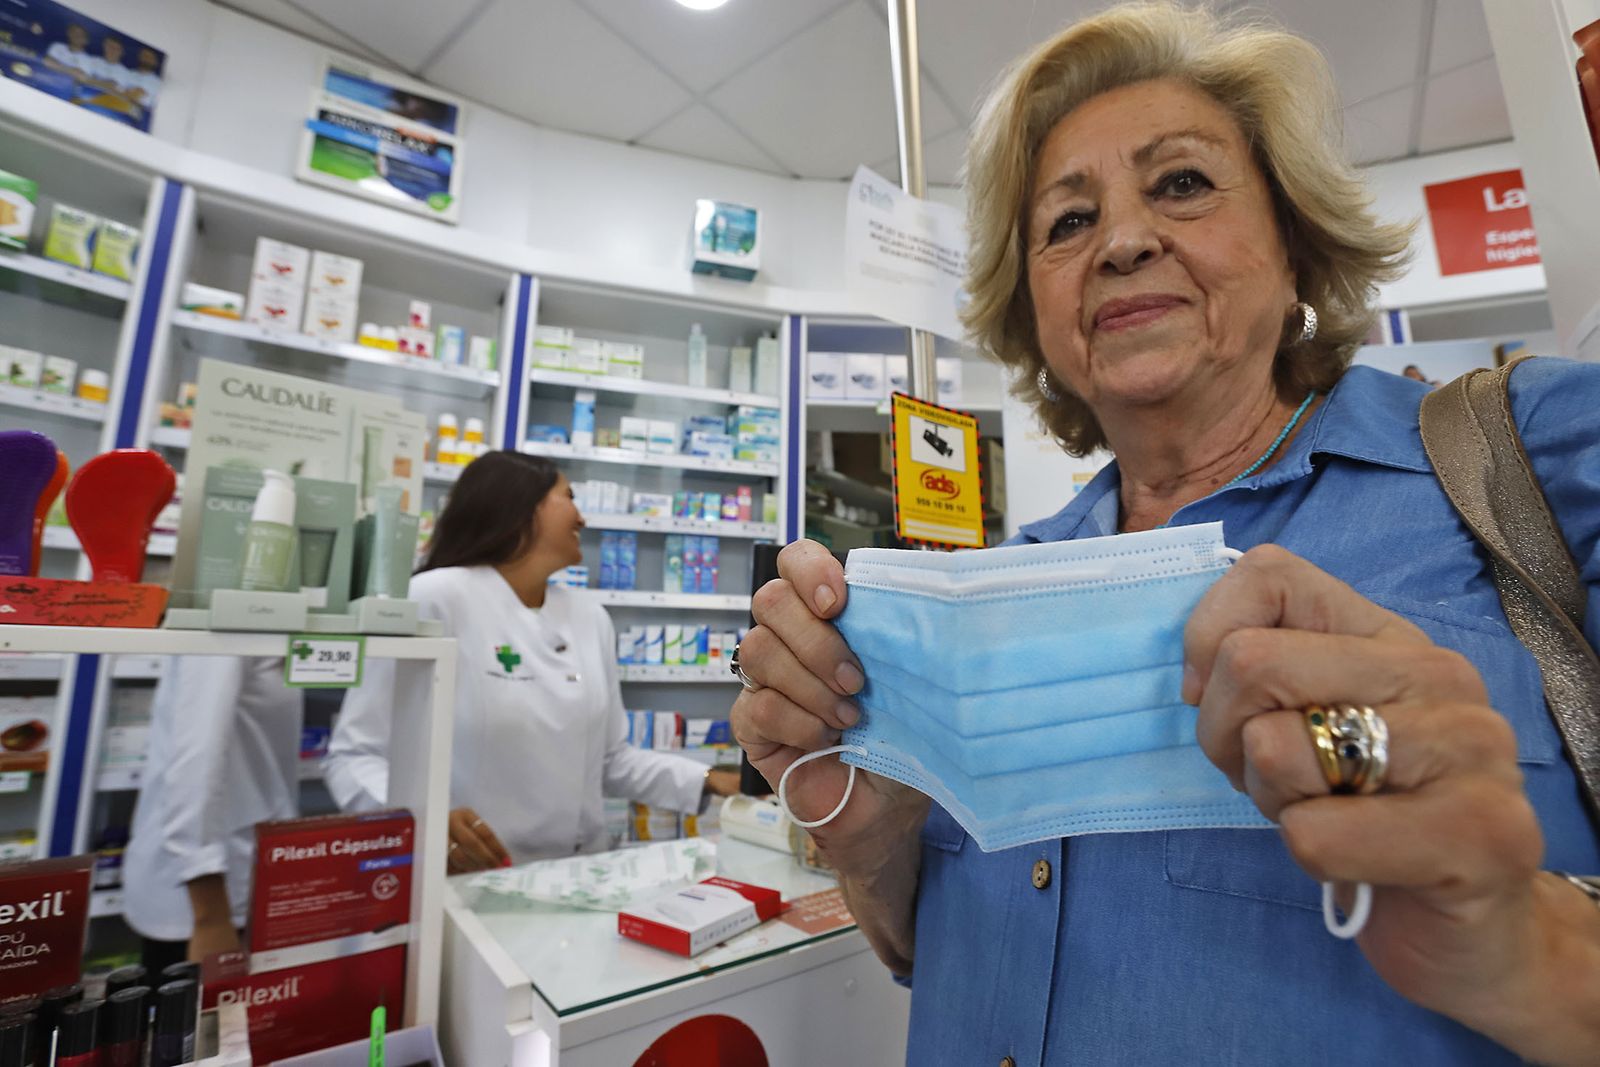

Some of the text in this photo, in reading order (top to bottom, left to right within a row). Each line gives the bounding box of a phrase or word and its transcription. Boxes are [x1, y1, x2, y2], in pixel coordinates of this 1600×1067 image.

[925, 473, 956, 495] ads
[271, 834, 403, 863] Pilexil Cápsulas
[0, 943, 51, 960] AÍDA
[217, 976, 300, 1009] Pilexil
